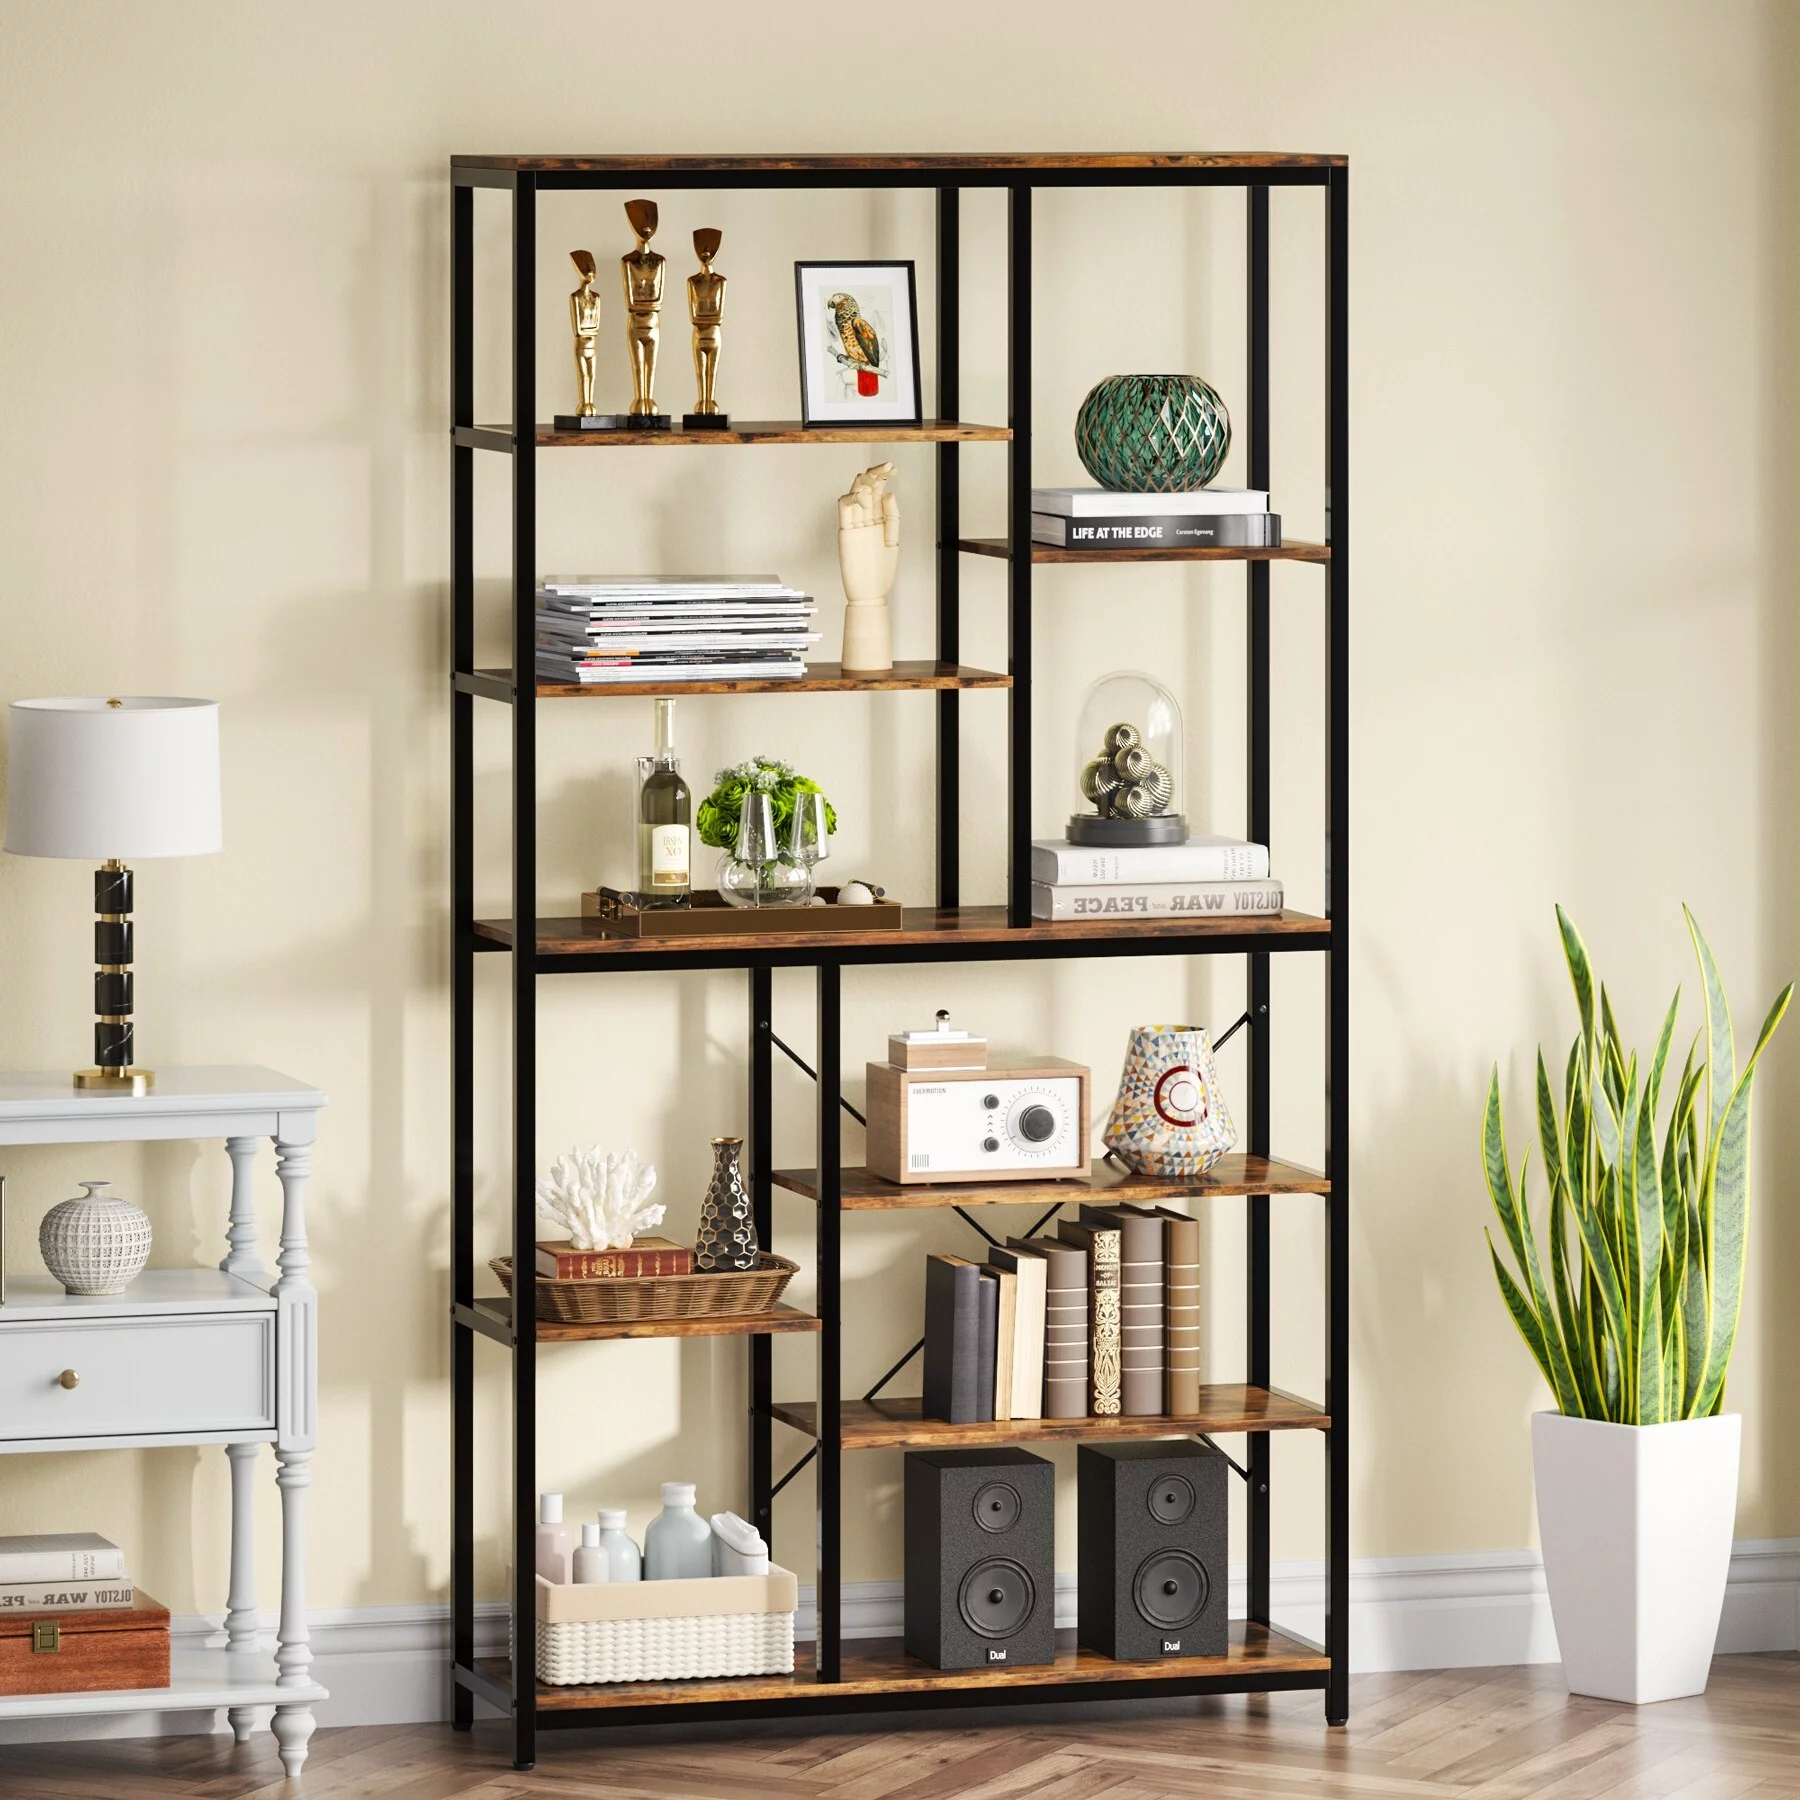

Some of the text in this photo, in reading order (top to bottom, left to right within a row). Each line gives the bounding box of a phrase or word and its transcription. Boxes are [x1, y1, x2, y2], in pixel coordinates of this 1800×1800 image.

[1072, 526, 1163, 539] LIFE AT THE EDGE
[912, 1087, 947, 1095] EVERMOTION
[1164, 1640, 1181, 1651] Dual
[990, 1649, 1006, 1660] Dual
